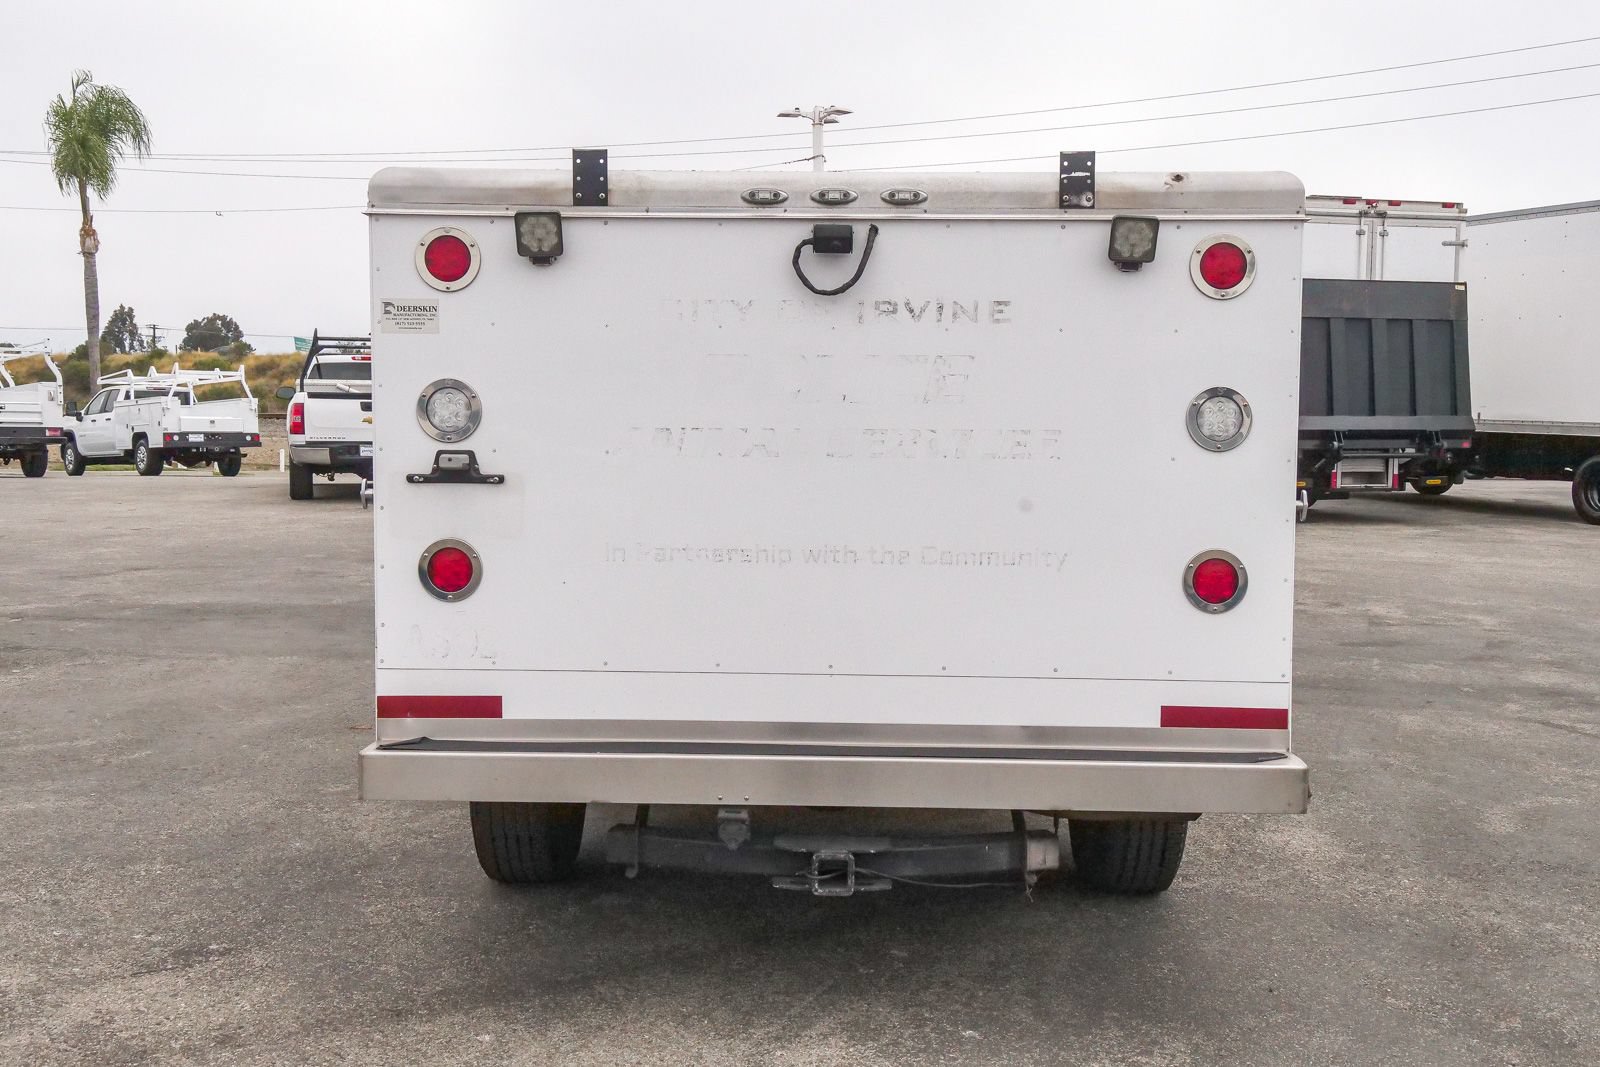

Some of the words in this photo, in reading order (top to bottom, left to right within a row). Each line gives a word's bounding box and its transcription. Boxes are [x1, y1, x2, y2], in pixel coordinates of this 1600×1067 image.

[857, 299, 1012, 323] IRVINE
[801, 544, 858, 566] with
[868, 546, 910, 567] the
